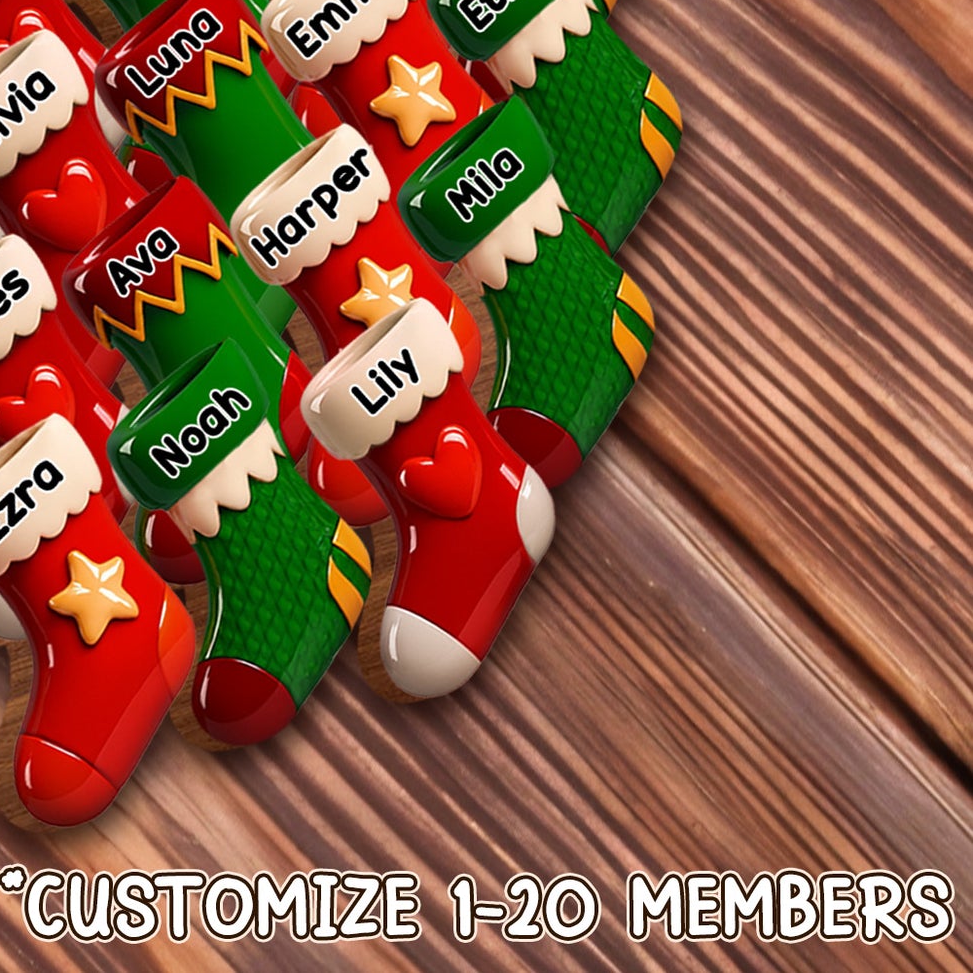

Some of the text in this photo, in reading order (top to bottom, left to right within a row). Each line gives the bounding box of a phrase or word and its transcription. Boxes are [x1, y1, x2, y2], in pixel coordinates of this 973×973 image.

[125, 9, 223, 98] Luna
[249, 146, 370, 268] Harper
[446, 146, 524, 222] Mila
[106, 227, 179, 297] Ava
[350, 348, 420, 415] Lily
[150, 385, 251, 479] Noah
